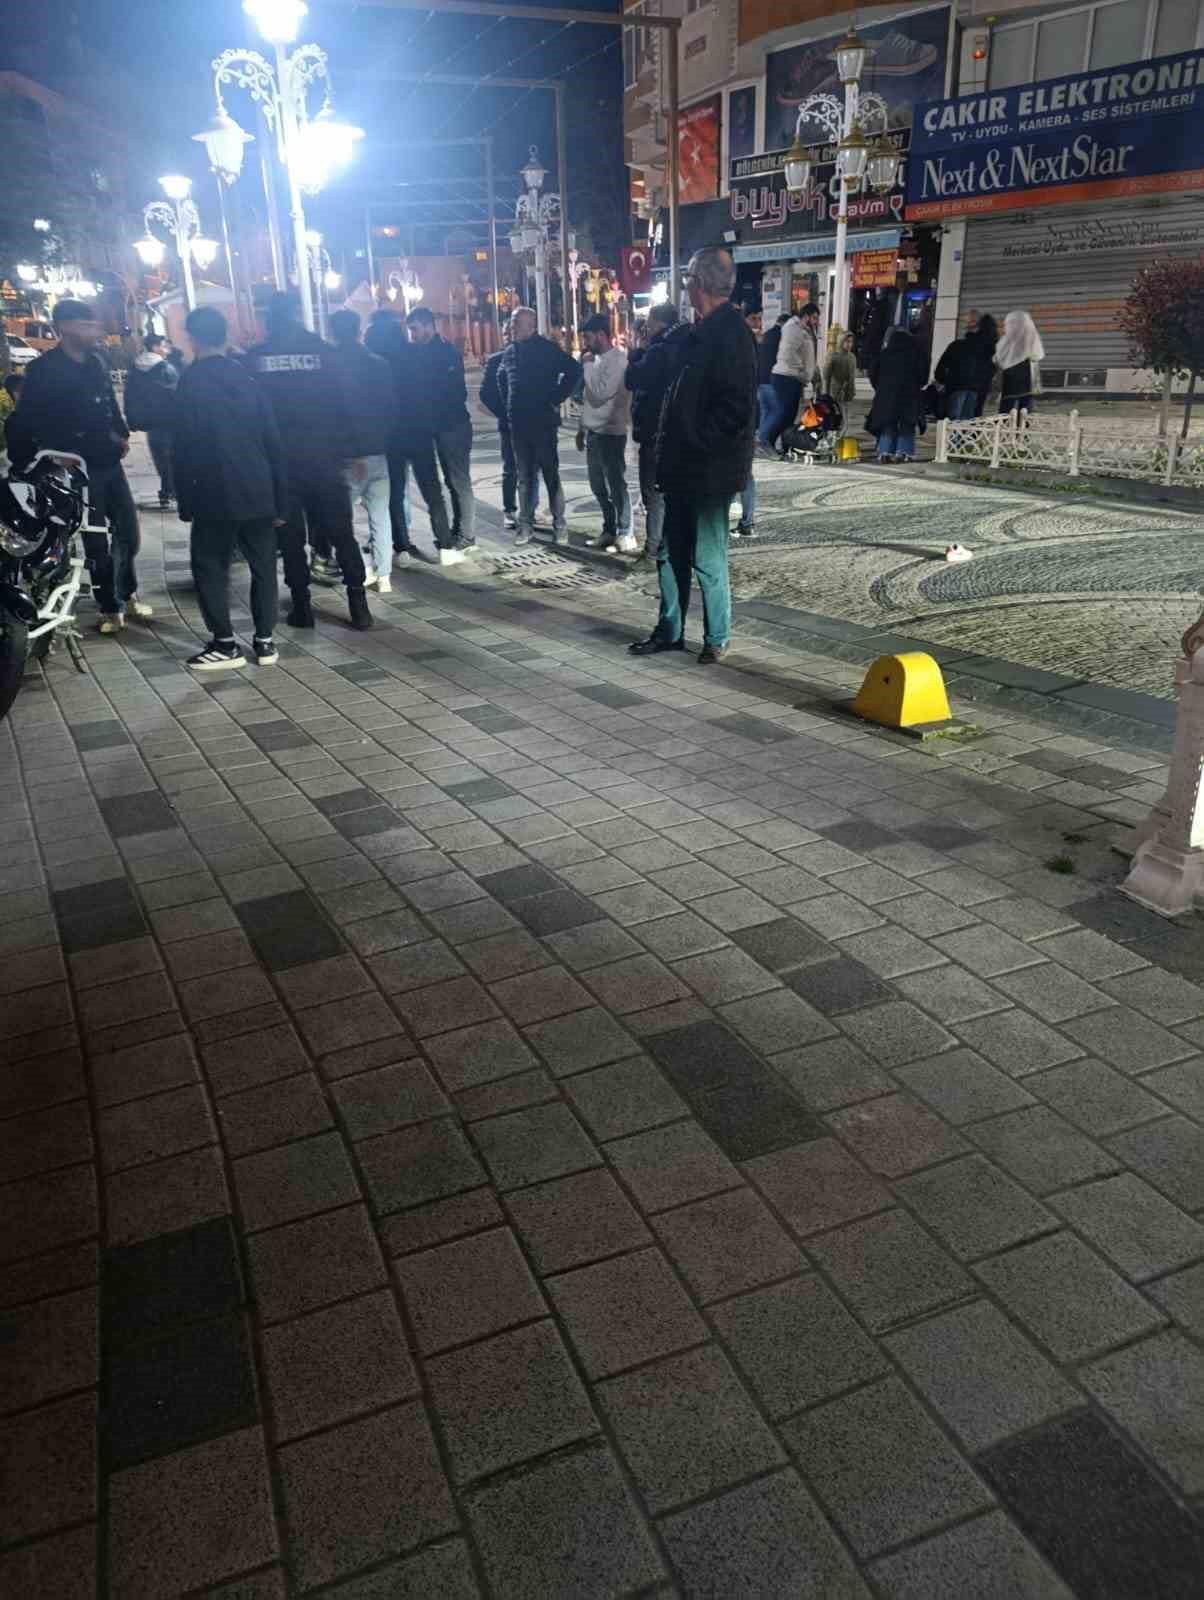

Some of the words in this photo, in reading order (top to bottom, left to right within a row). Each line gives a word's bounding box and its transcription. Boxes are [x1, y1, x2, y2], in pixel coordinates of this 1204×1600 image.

[923, 96, 1007, 137] ÇAKIR
[1016, 57, 1204, 116] ELEKTRONİ
[951, 131, 966, 143] TV
[975, 125, 1007, 139] UYDU
[1018, 114, 1071, 133] KAMERA
[1082, 109, 1107, 123] SES
[920, 157, 975, 199] Next
[979, 148, 1006, 191] &
[1008, 134, 1134, 188] NextStar
